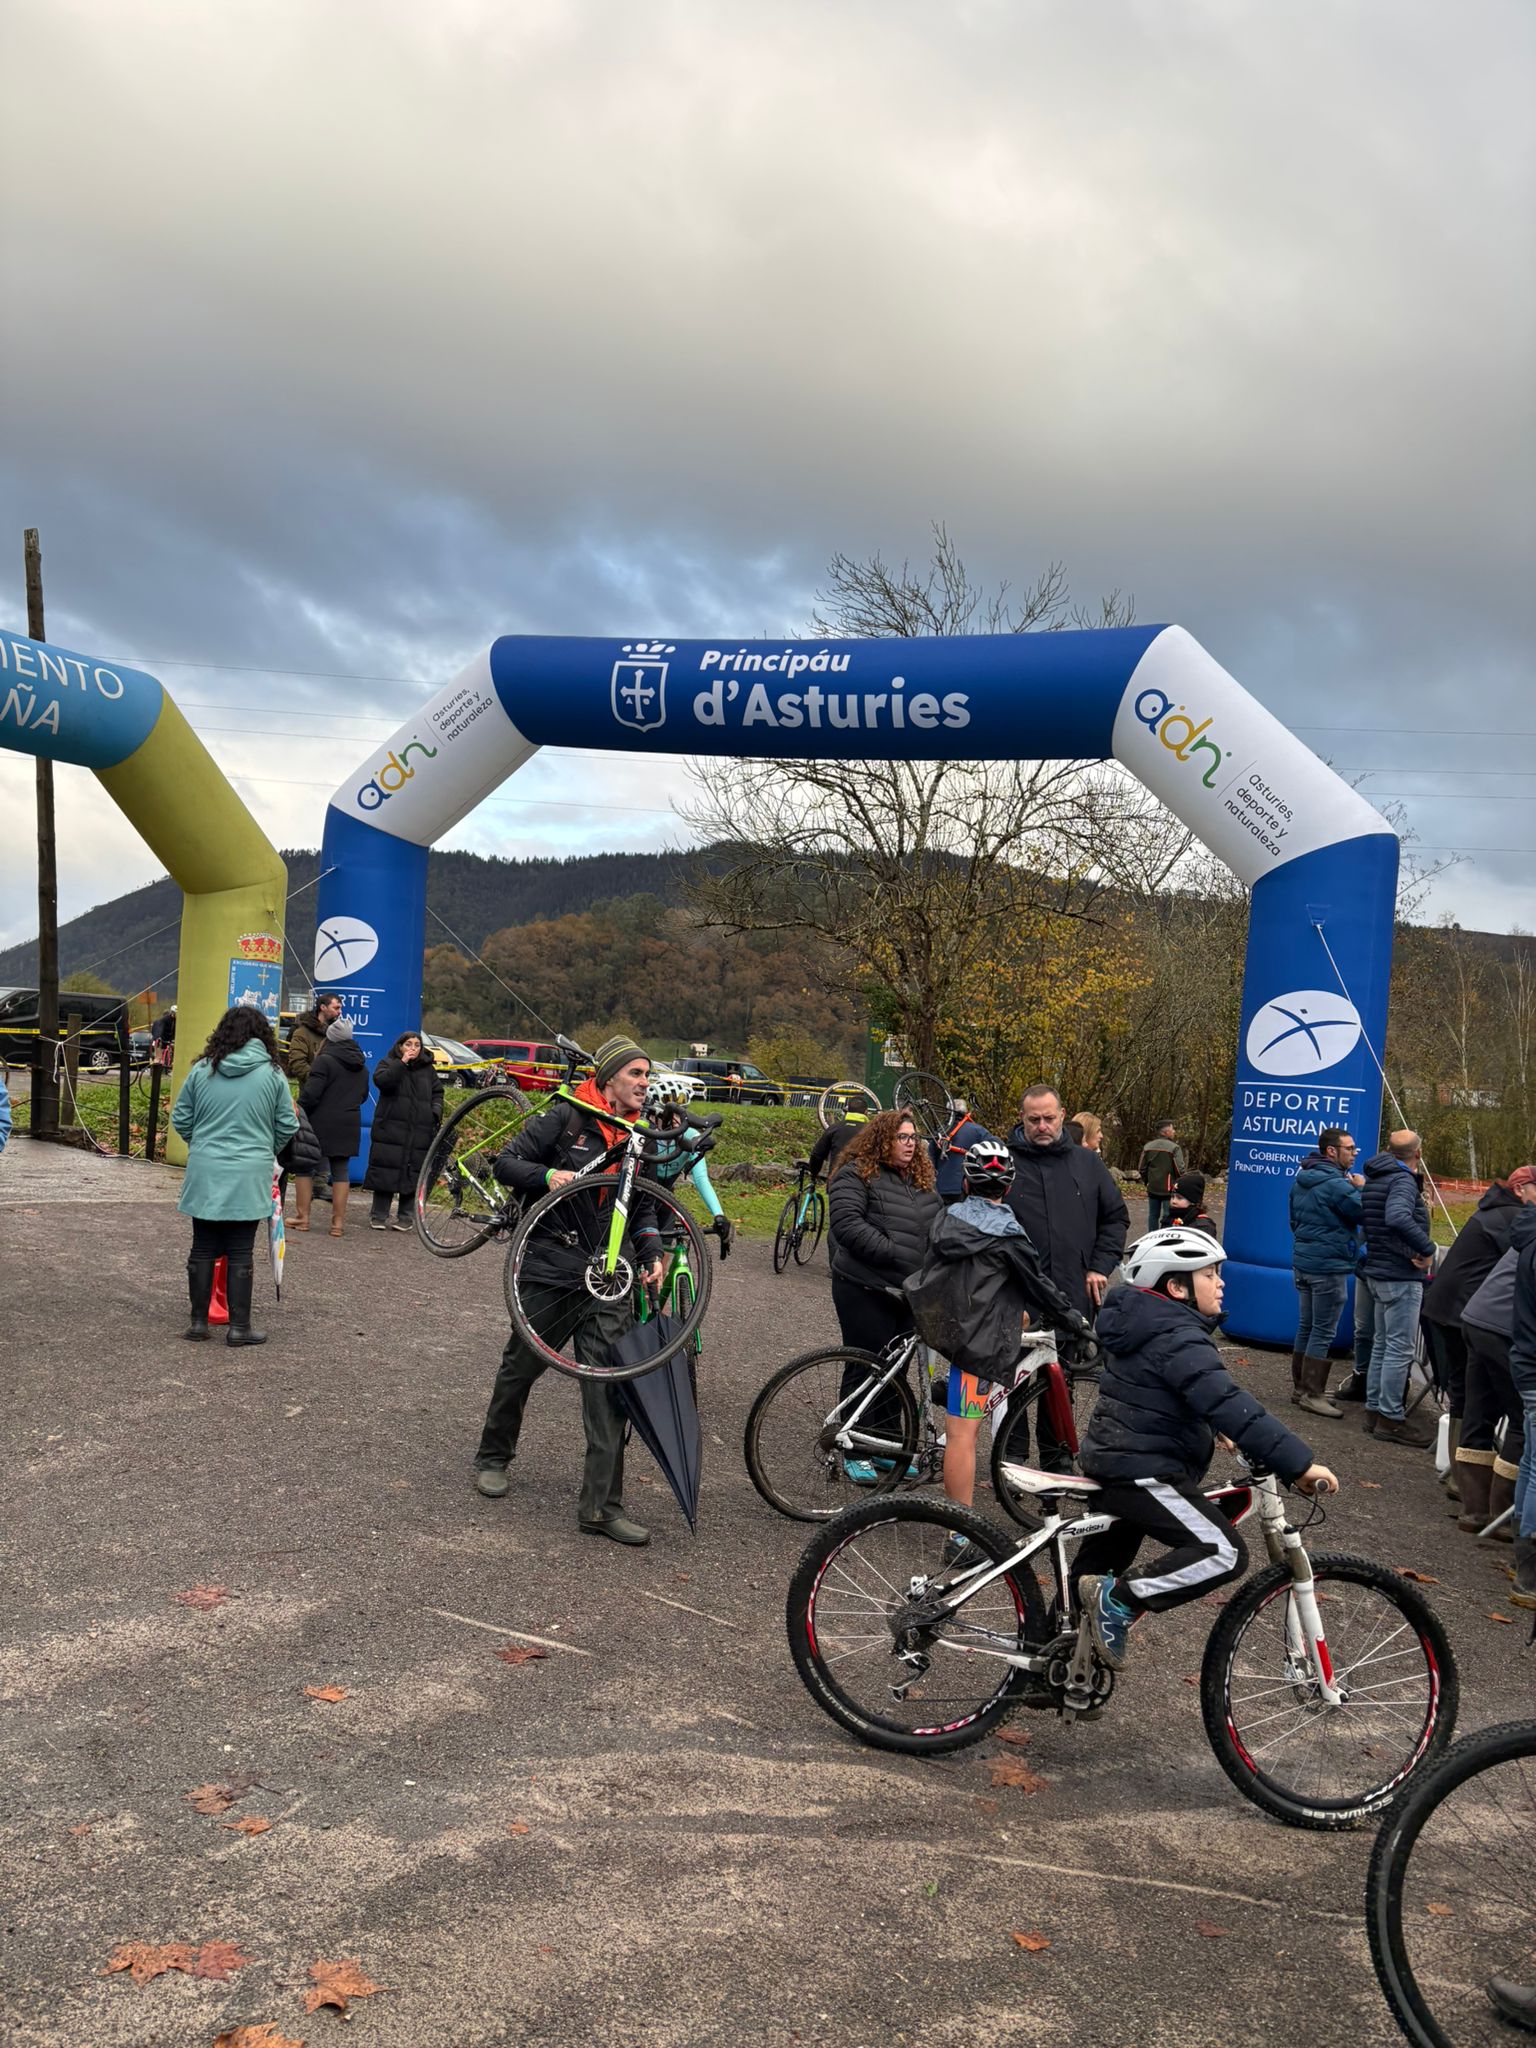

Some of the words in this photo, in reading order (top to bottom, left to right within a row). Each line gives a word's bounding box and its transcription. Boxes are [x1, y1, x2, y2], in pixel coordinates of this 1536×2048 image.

[0, 637, 124, 700] ENTO
[699, 648, 851, 679] Principáu
[439, 698, 473, 731] deporte
[472, 691, 481, 702] y
[447, 696, 493, 742] naturaleza
[1223, 799, 1282, 857] naturaleza
[1236, 786, 1280, 831] deporte
[1276, 830, 1289, 839] y
[1243, 1091, 1351, 1114] DEPORTE
[574, 1151, 607, 1180] dale
[1302, 1794, 1394, 1820] SCHWALBE
